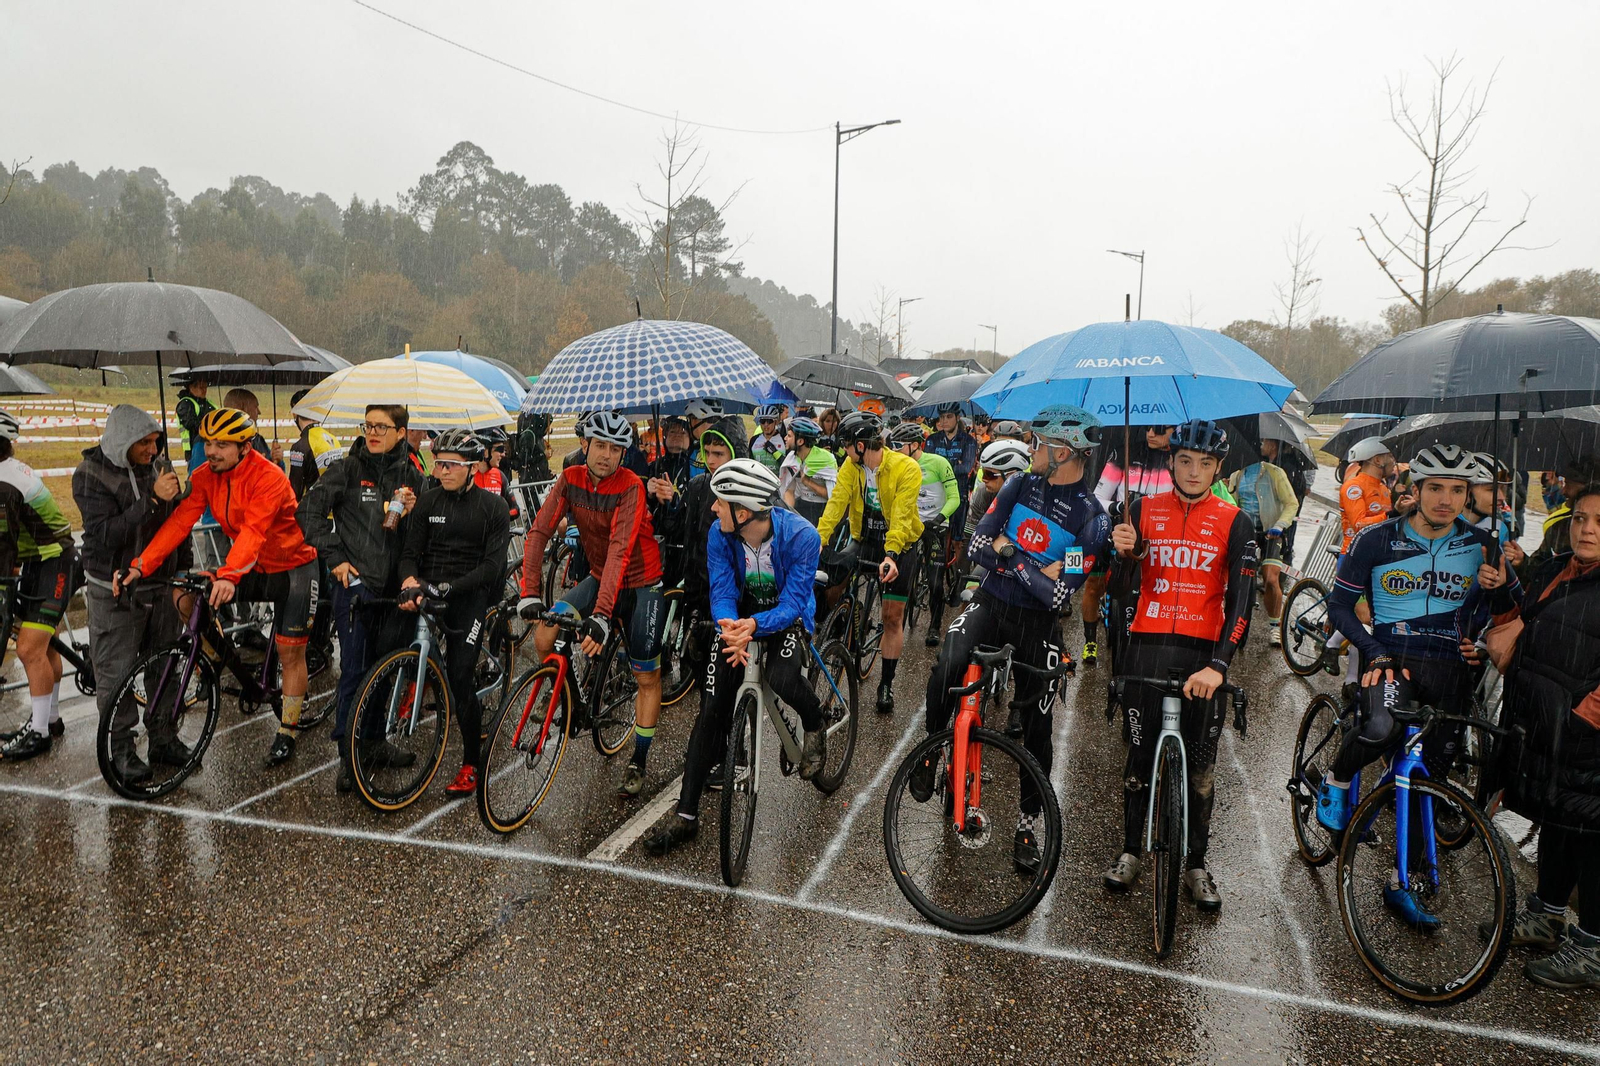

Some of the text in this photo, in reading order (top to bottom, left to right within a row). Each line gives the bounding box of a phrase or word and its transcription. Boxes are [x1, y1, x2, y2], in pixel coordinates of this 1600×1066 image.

[1022, 527, 1044, 545] RP
[1201, 528, 1213, 536] BH
[1067, 554, 1081, 567] 30
[1149, 546, 1218, 572] FROIZ
[1422, 571, 1463, 587] que
[1162, 604, 1188, 612] XUNTA
[1173, 613, 1204, 621] GALICIA
[466, 618, 482, 645] FROIZ
[1229, 616, 1248, 644] FROIZ
[1128, 708, 1143, 746] Galicia
